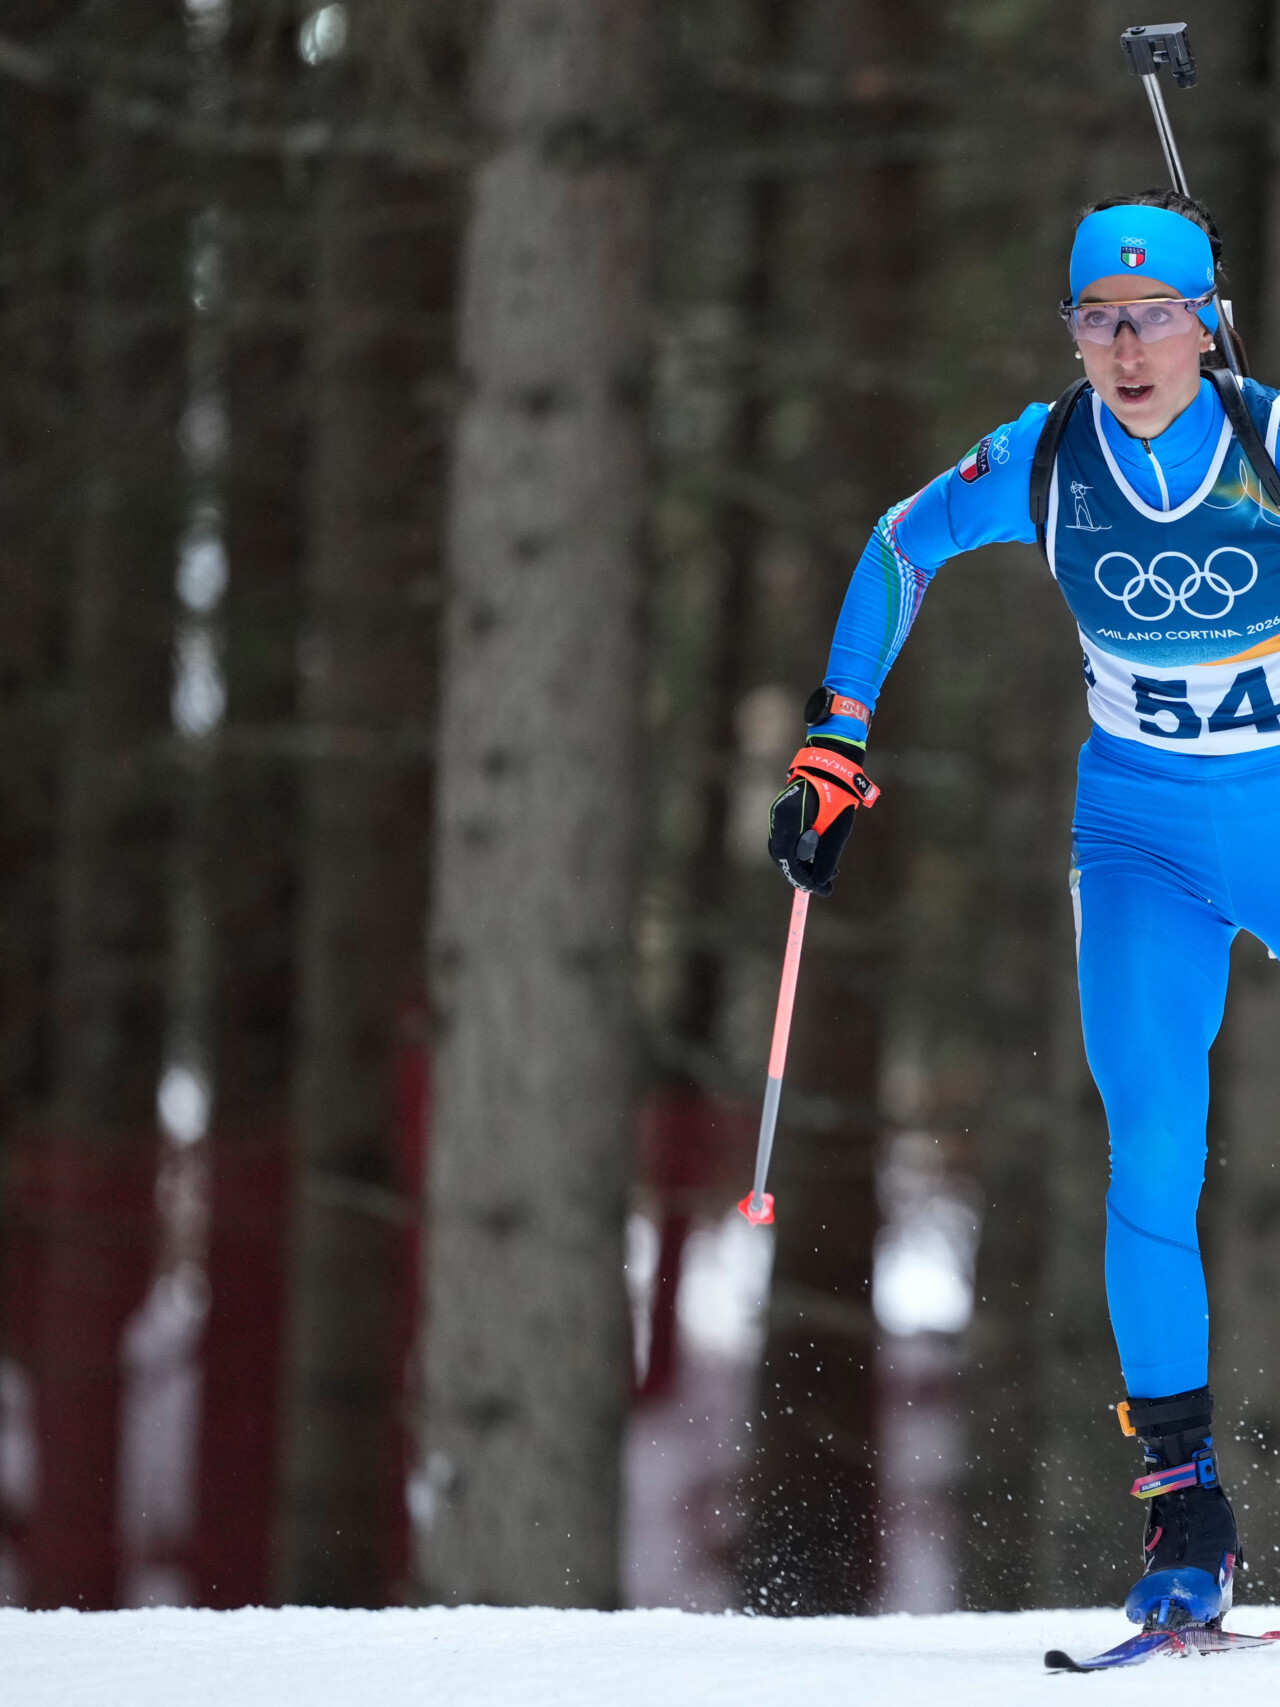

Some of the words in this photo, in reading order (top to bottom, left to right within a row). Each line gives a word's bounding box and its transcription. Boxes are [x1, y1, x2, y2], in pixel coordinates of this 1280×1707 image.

[981, 438, 992, 472] ITALIA
[1096, 628, 1162, 641] MILANO
[1165, 629, 1243, 640] CORTINA
[1246, 616, 1280, 636] 2026
